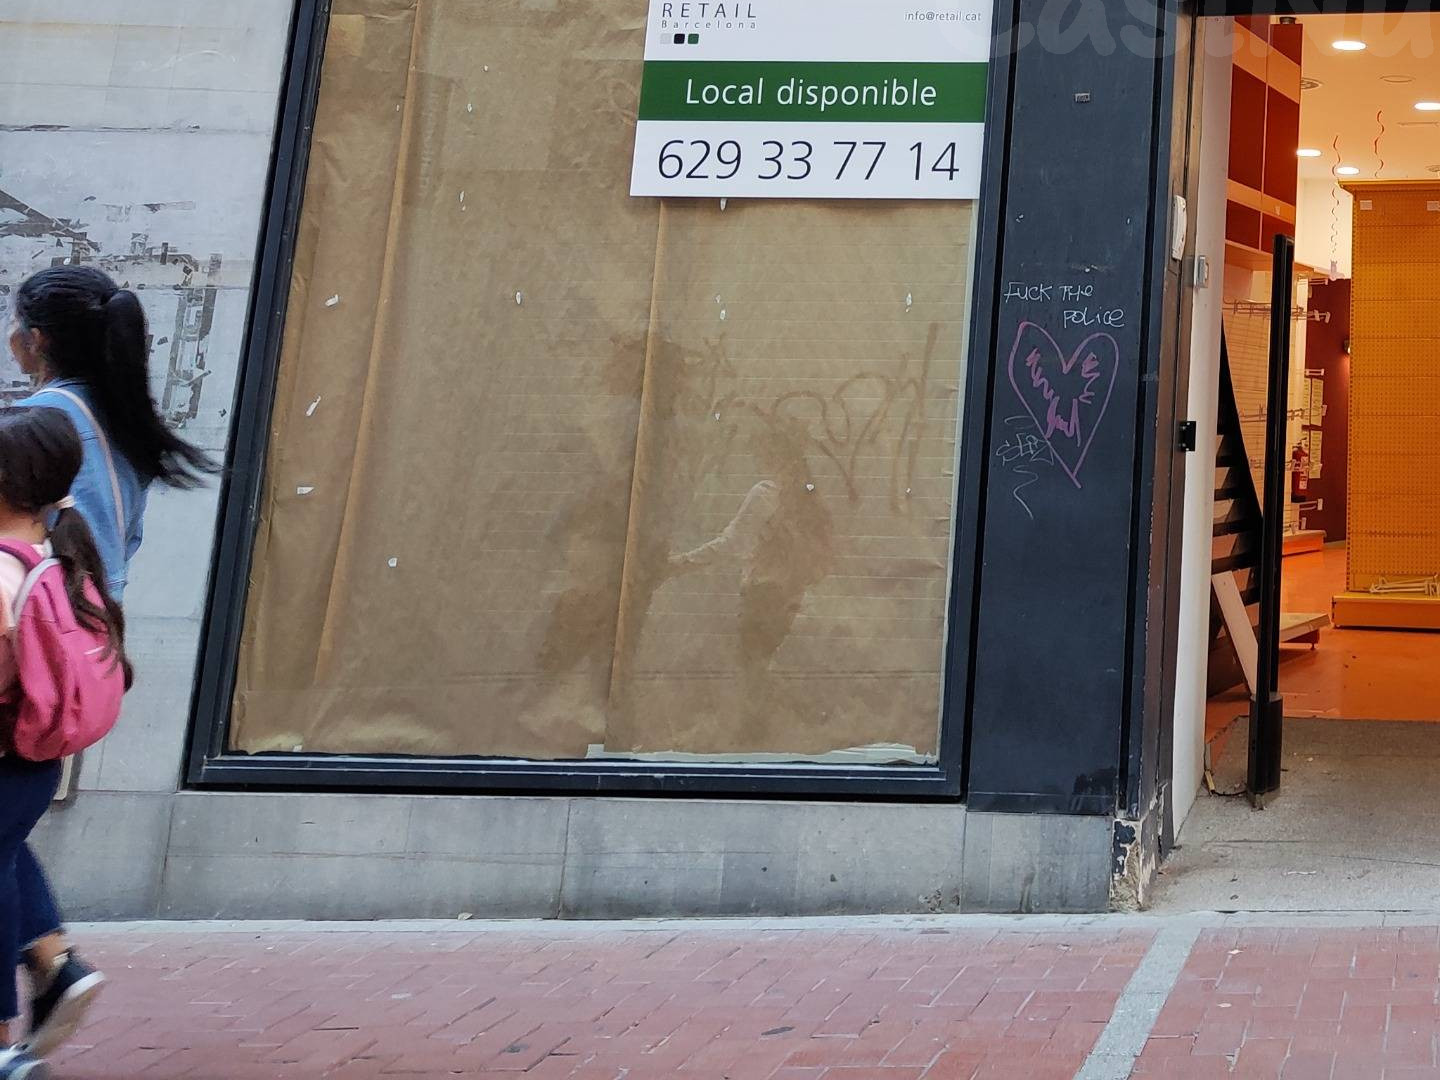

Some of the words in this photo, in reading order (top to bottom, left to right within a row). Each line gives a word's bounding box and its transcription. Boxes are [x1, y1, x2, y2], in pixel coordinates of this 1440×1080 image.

[662, 3, 757, 18] RETAIL
[661, 21, 756, 29] Barcelona
[686, 78, 763, 104] Local
[777, 78, 937, 111] disponible
[658, 139, 742, 179] 629
[758, 140, 813, 180] 33
[833, 141, 887, 180] 77
[909, 141, 959, 181] 14
[1004, 281, 1052, 302] FUCK
